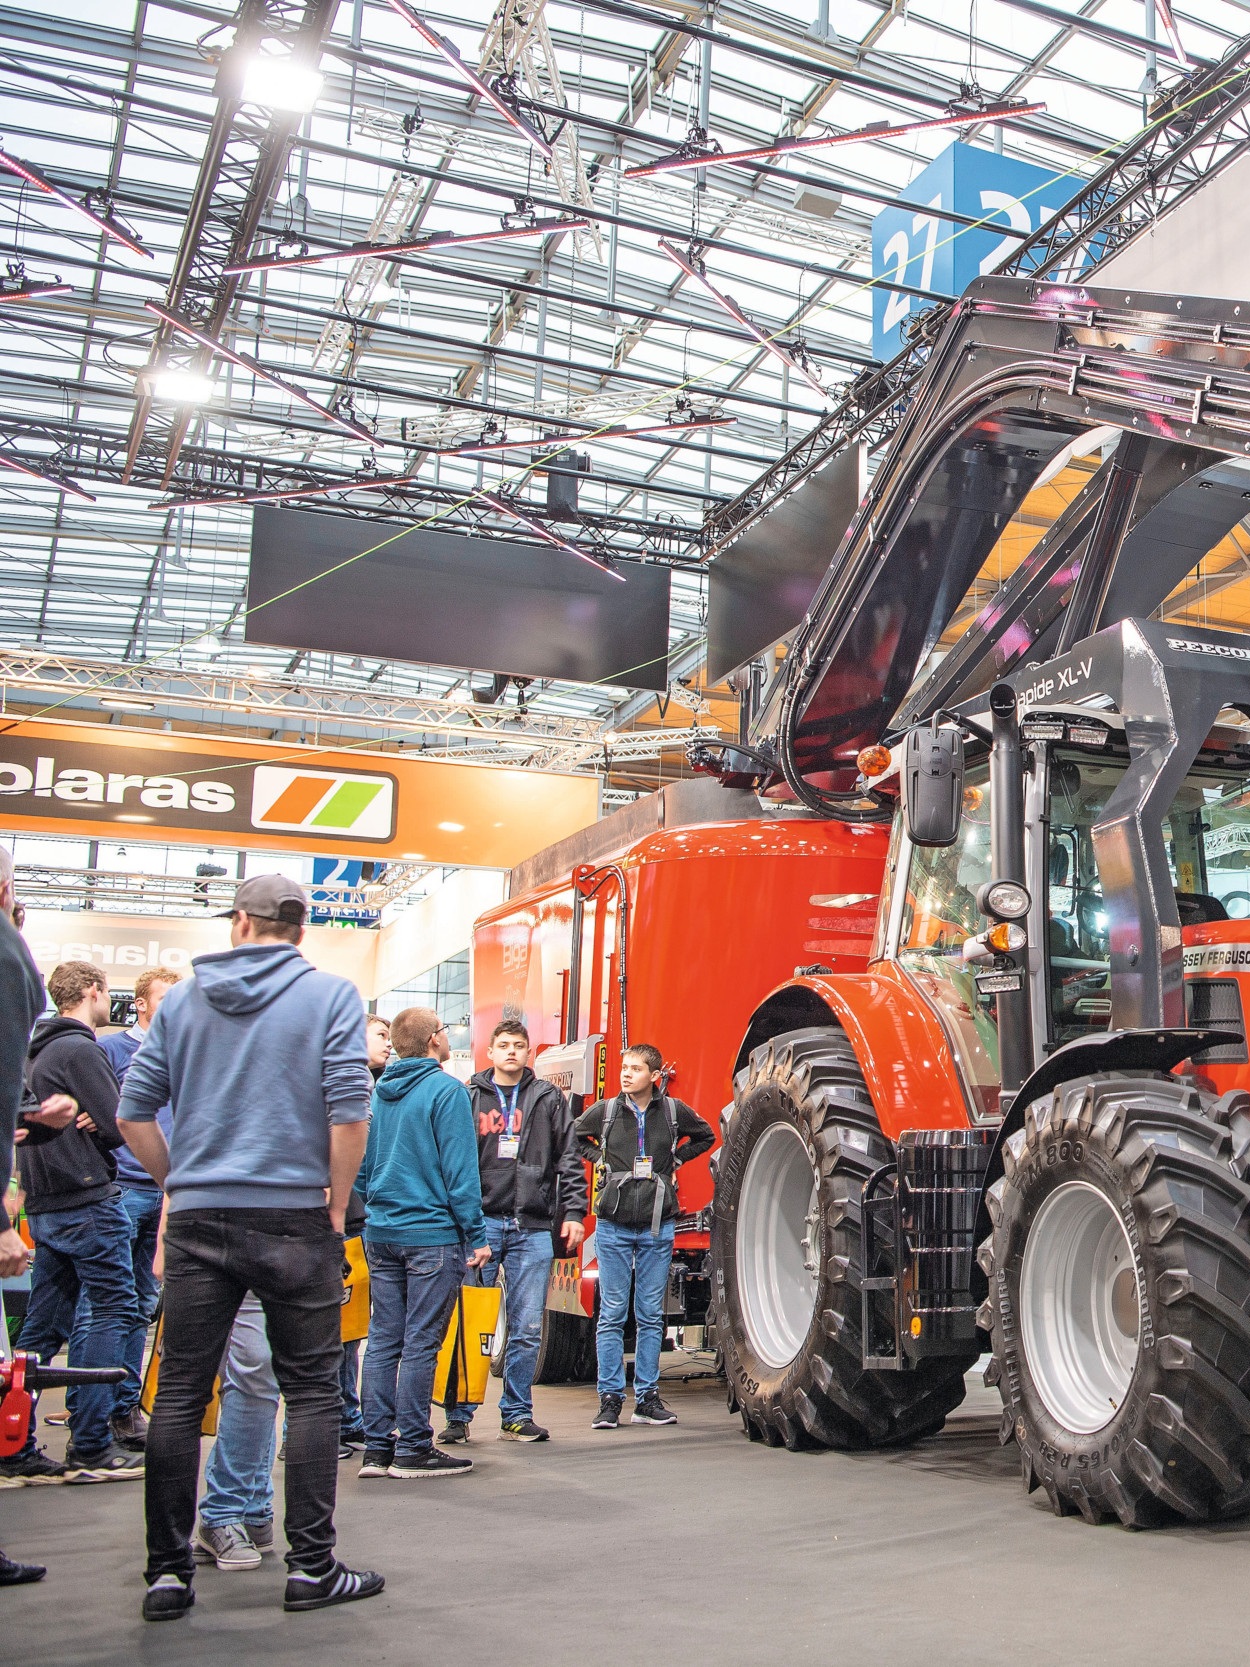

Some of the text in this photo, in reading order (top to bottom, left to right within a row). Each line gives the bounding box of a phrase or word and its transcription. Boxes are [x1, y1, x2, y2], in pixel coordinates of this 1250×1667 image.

[883, 192, 942, 335] 27
[1015, 657, 1092, 706] apide XL-V
[1046, 1140, 1085, 1167] 800
